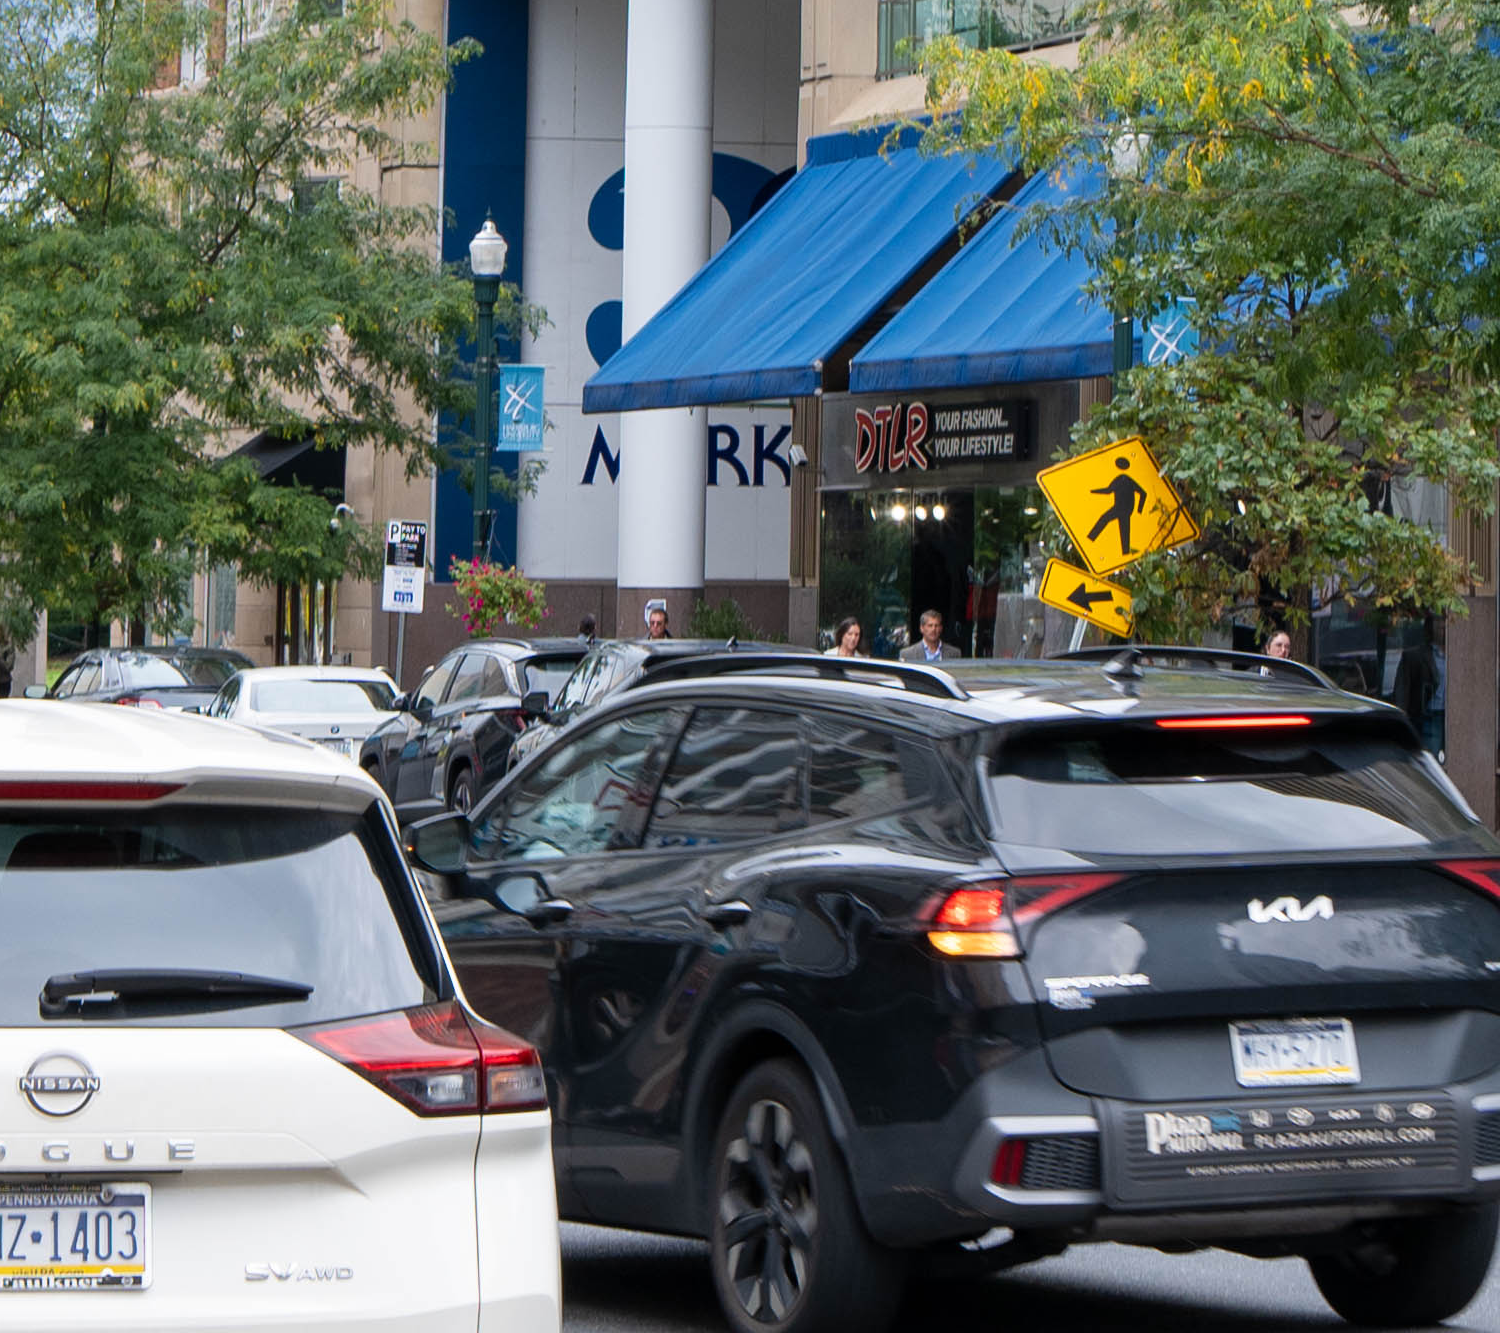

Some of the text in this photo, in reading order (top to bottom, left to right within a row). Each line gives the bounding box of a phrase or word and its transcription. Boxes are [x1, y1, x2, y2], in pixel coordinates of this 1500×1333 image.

[935, 407, 1009, 432] YOUR FASHION...
[855, 401, 928, 474] DTLR
[935, 434, 1014, 458] YOUR LIFESTYLE!
[580, 423, 792, 486] MRK
[401, 525, 415, 534] PAY
[416, 526, 426, 535] TO
[19, 1077, 100, 1092] NISSAN
[244, 1262, 353, 1282] SV AWD
